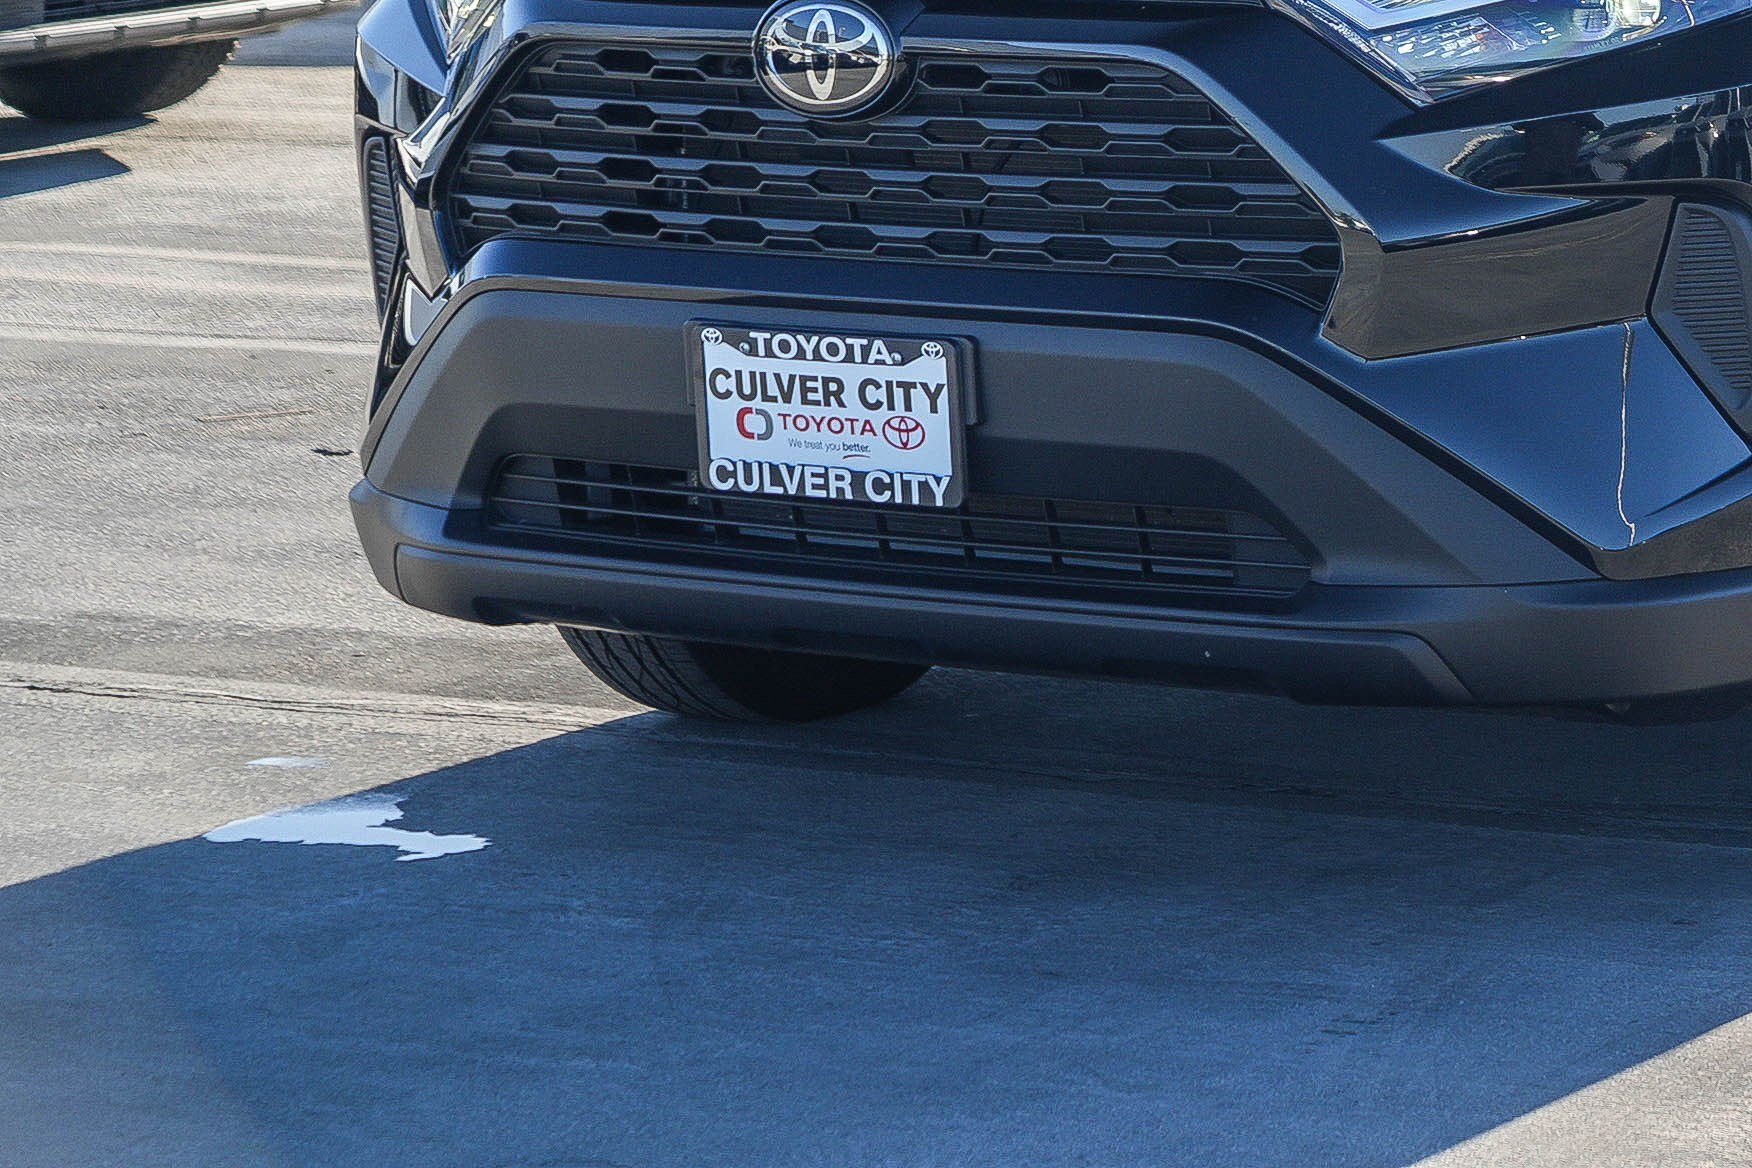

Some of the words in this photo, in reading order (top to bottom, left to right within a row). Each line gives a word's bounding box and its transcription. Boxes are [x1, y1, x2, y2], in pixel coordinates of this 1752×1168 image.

[749, 331, 894, 365] TOYOTA
[709, 368, 847, 409] CULVER
[858, 378, 946, 414] CITY
[777, 413, 878, 437] TOYOTA
[788, 438, 802, 448] We
[825, 442, 841, 452] you
[709, 458, 853, 500] CULVER
[864, 470, 951, 507] CITY
